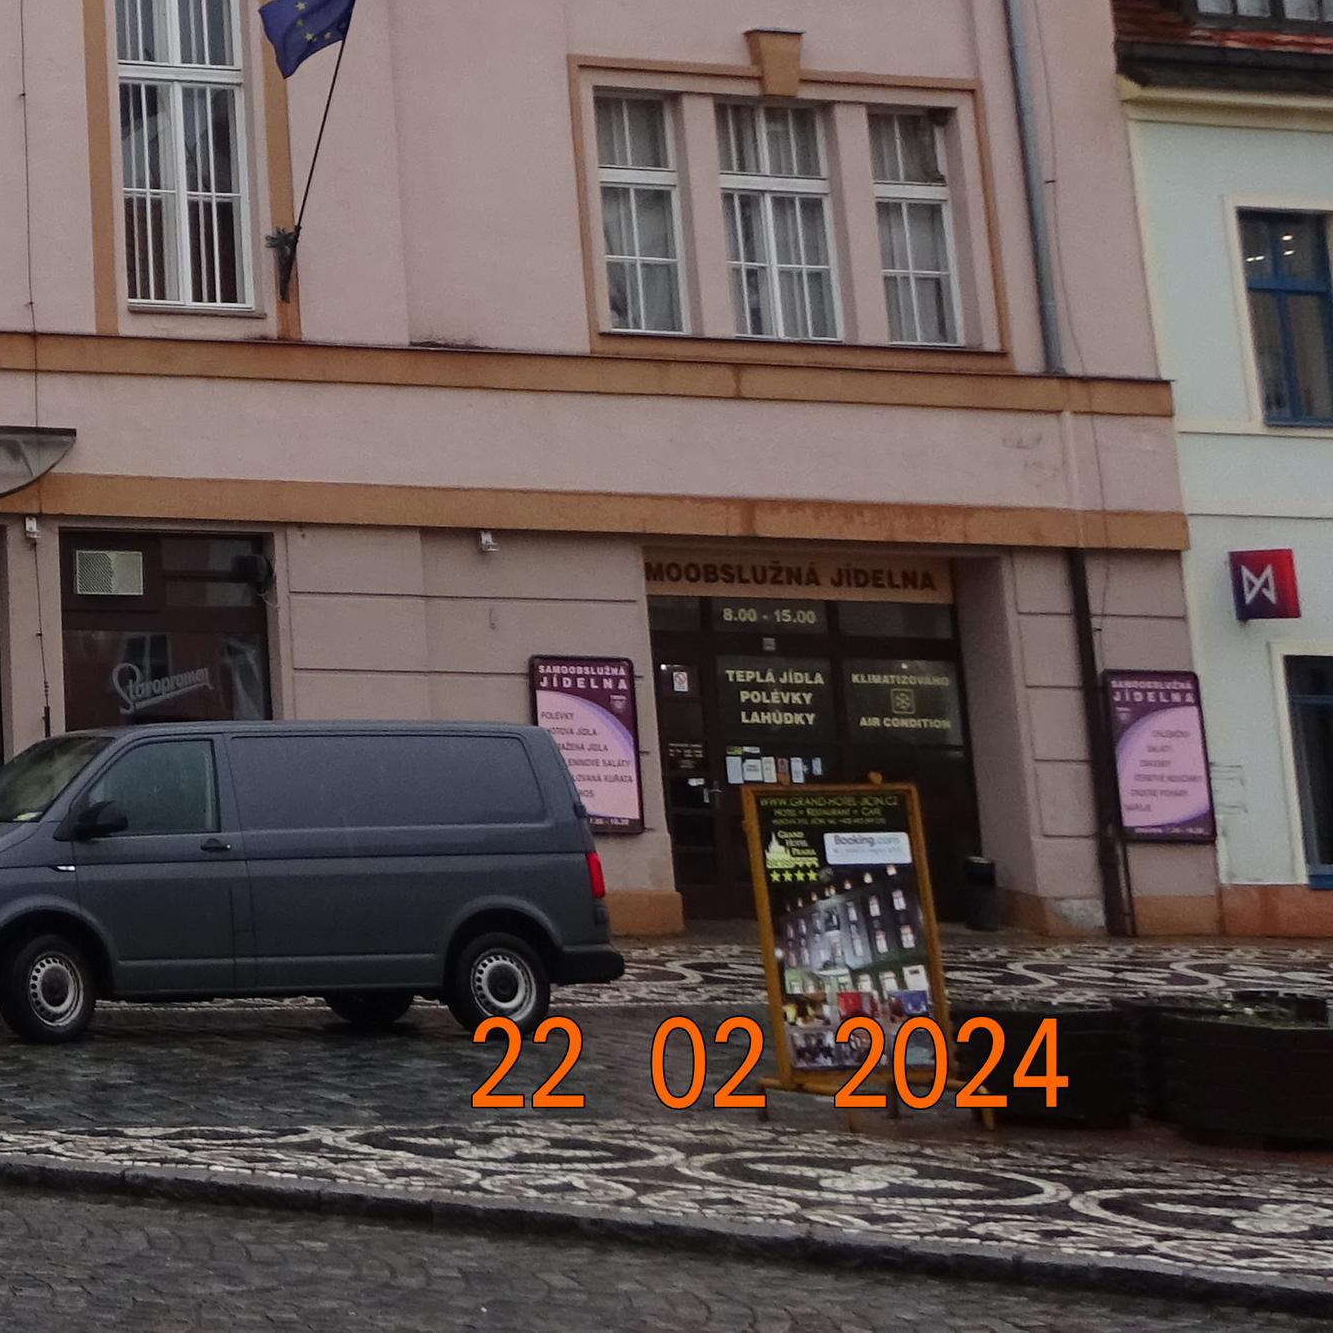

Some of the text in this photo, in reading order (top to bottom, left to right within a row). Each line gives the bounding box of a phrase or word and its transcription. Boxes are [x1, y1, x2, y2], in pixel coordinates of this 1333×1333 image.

[645, 561, 937, 591] MOOBSLUŽNÁ JÍDELNA
[722, 608, 758, 623] 8.00
[772, 608, 817, 624] 15.00
[538, 664, 626, 676] SAMOOBSLUŽNÁ
[725, 667, 825, 685] TEPLÁ JÍDLA
[539, 675, 628, 690] JÍDELNA
[739, 688, 813, 705] POLÉVKY
[1112, 689, 1195, 703] JÍDELNA
[741, 709, 816, 726] LAHŮDKY
[859, 717, 951, 730] AIR CONDITION
[833, 834, 901, 847] Booking.com
